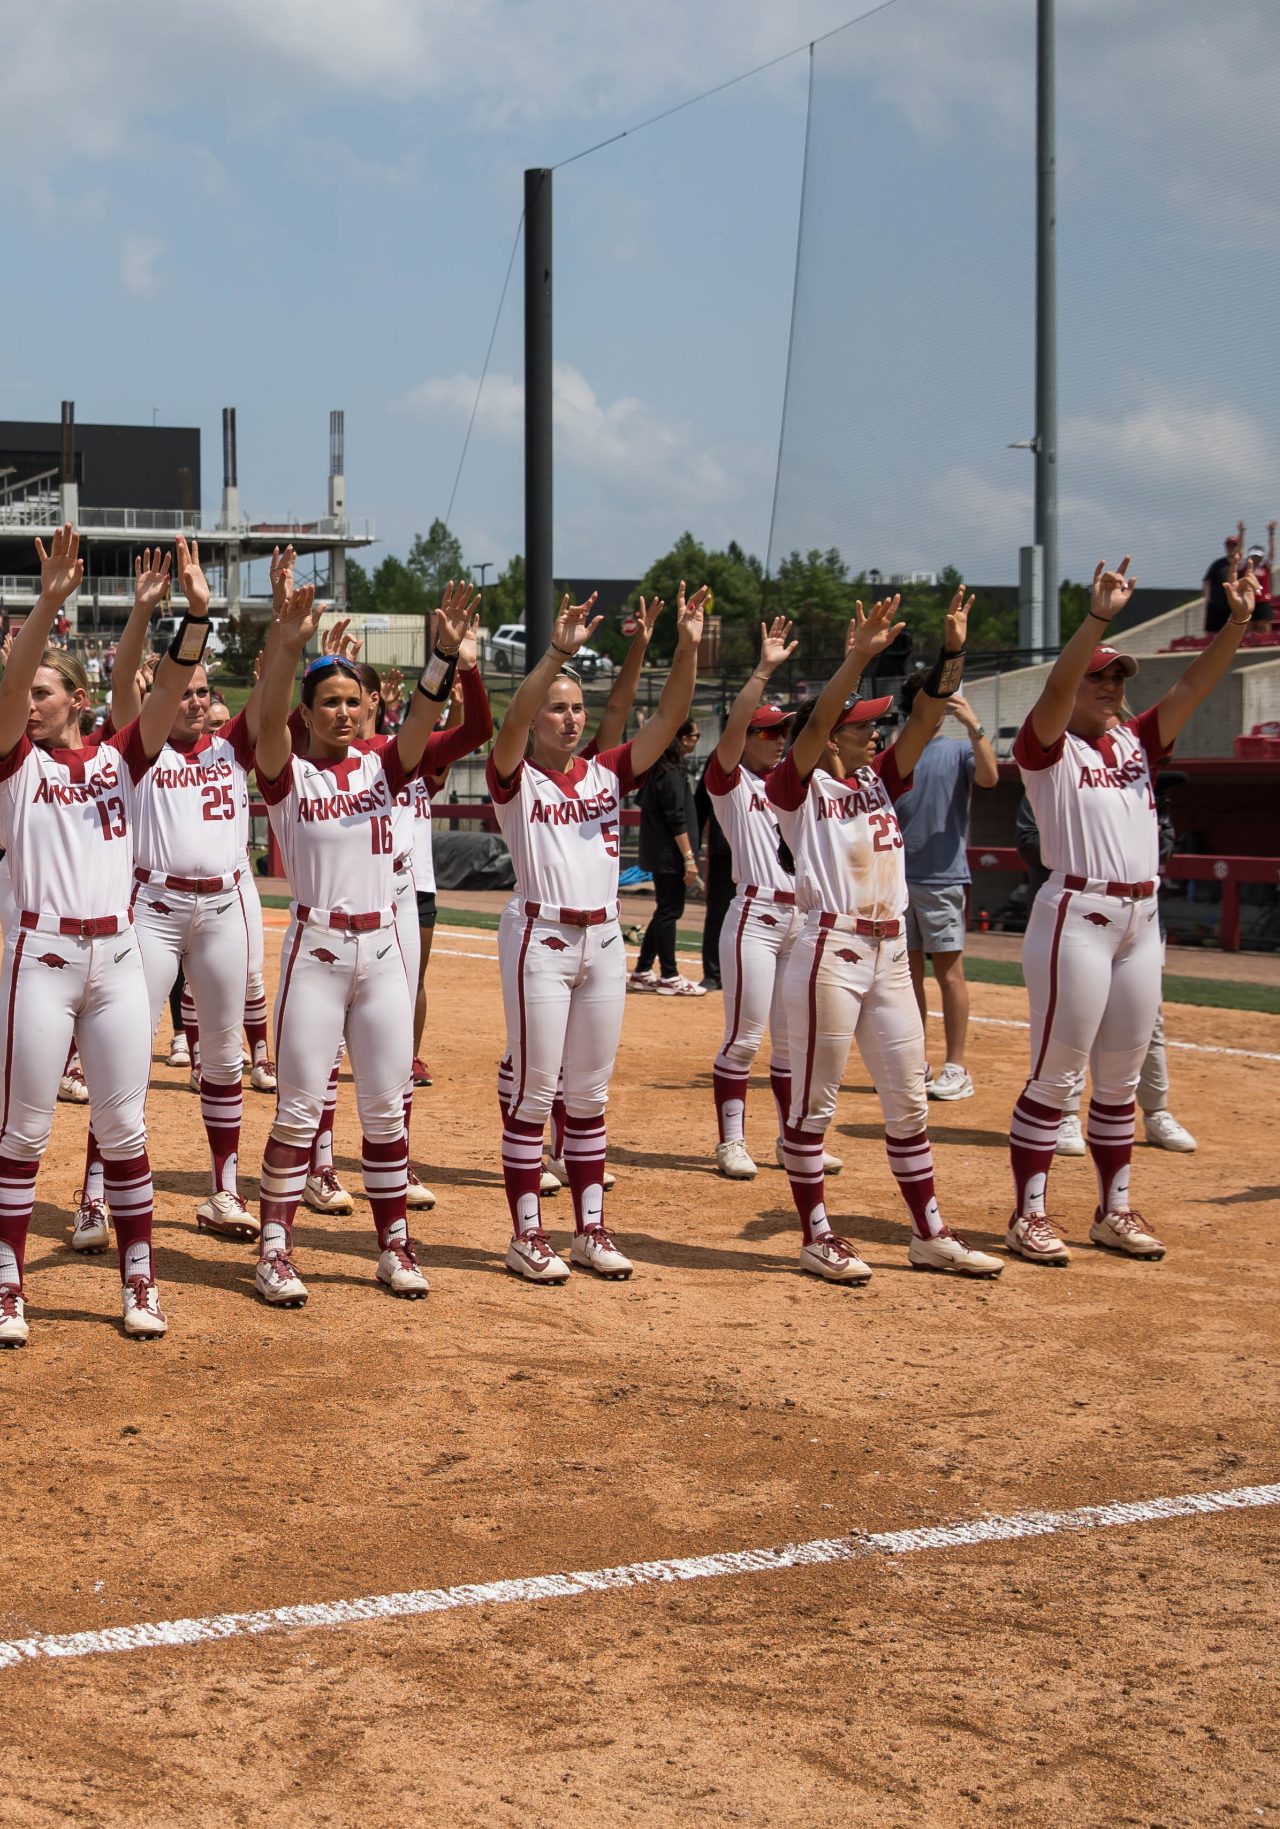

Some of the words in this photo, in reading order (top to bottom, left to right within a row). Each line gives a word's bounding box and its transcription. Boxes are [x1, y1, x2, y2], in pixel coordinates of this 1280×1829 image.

[96, 796, 126, 841] 13
[201, 784, 235, 821] 25
[297, 780, 386, 822] ARKANSAS
[370, 815, 393, 855] 16
[600, 820, 619, 857] 5
[869, 813, 904, 852] 23
